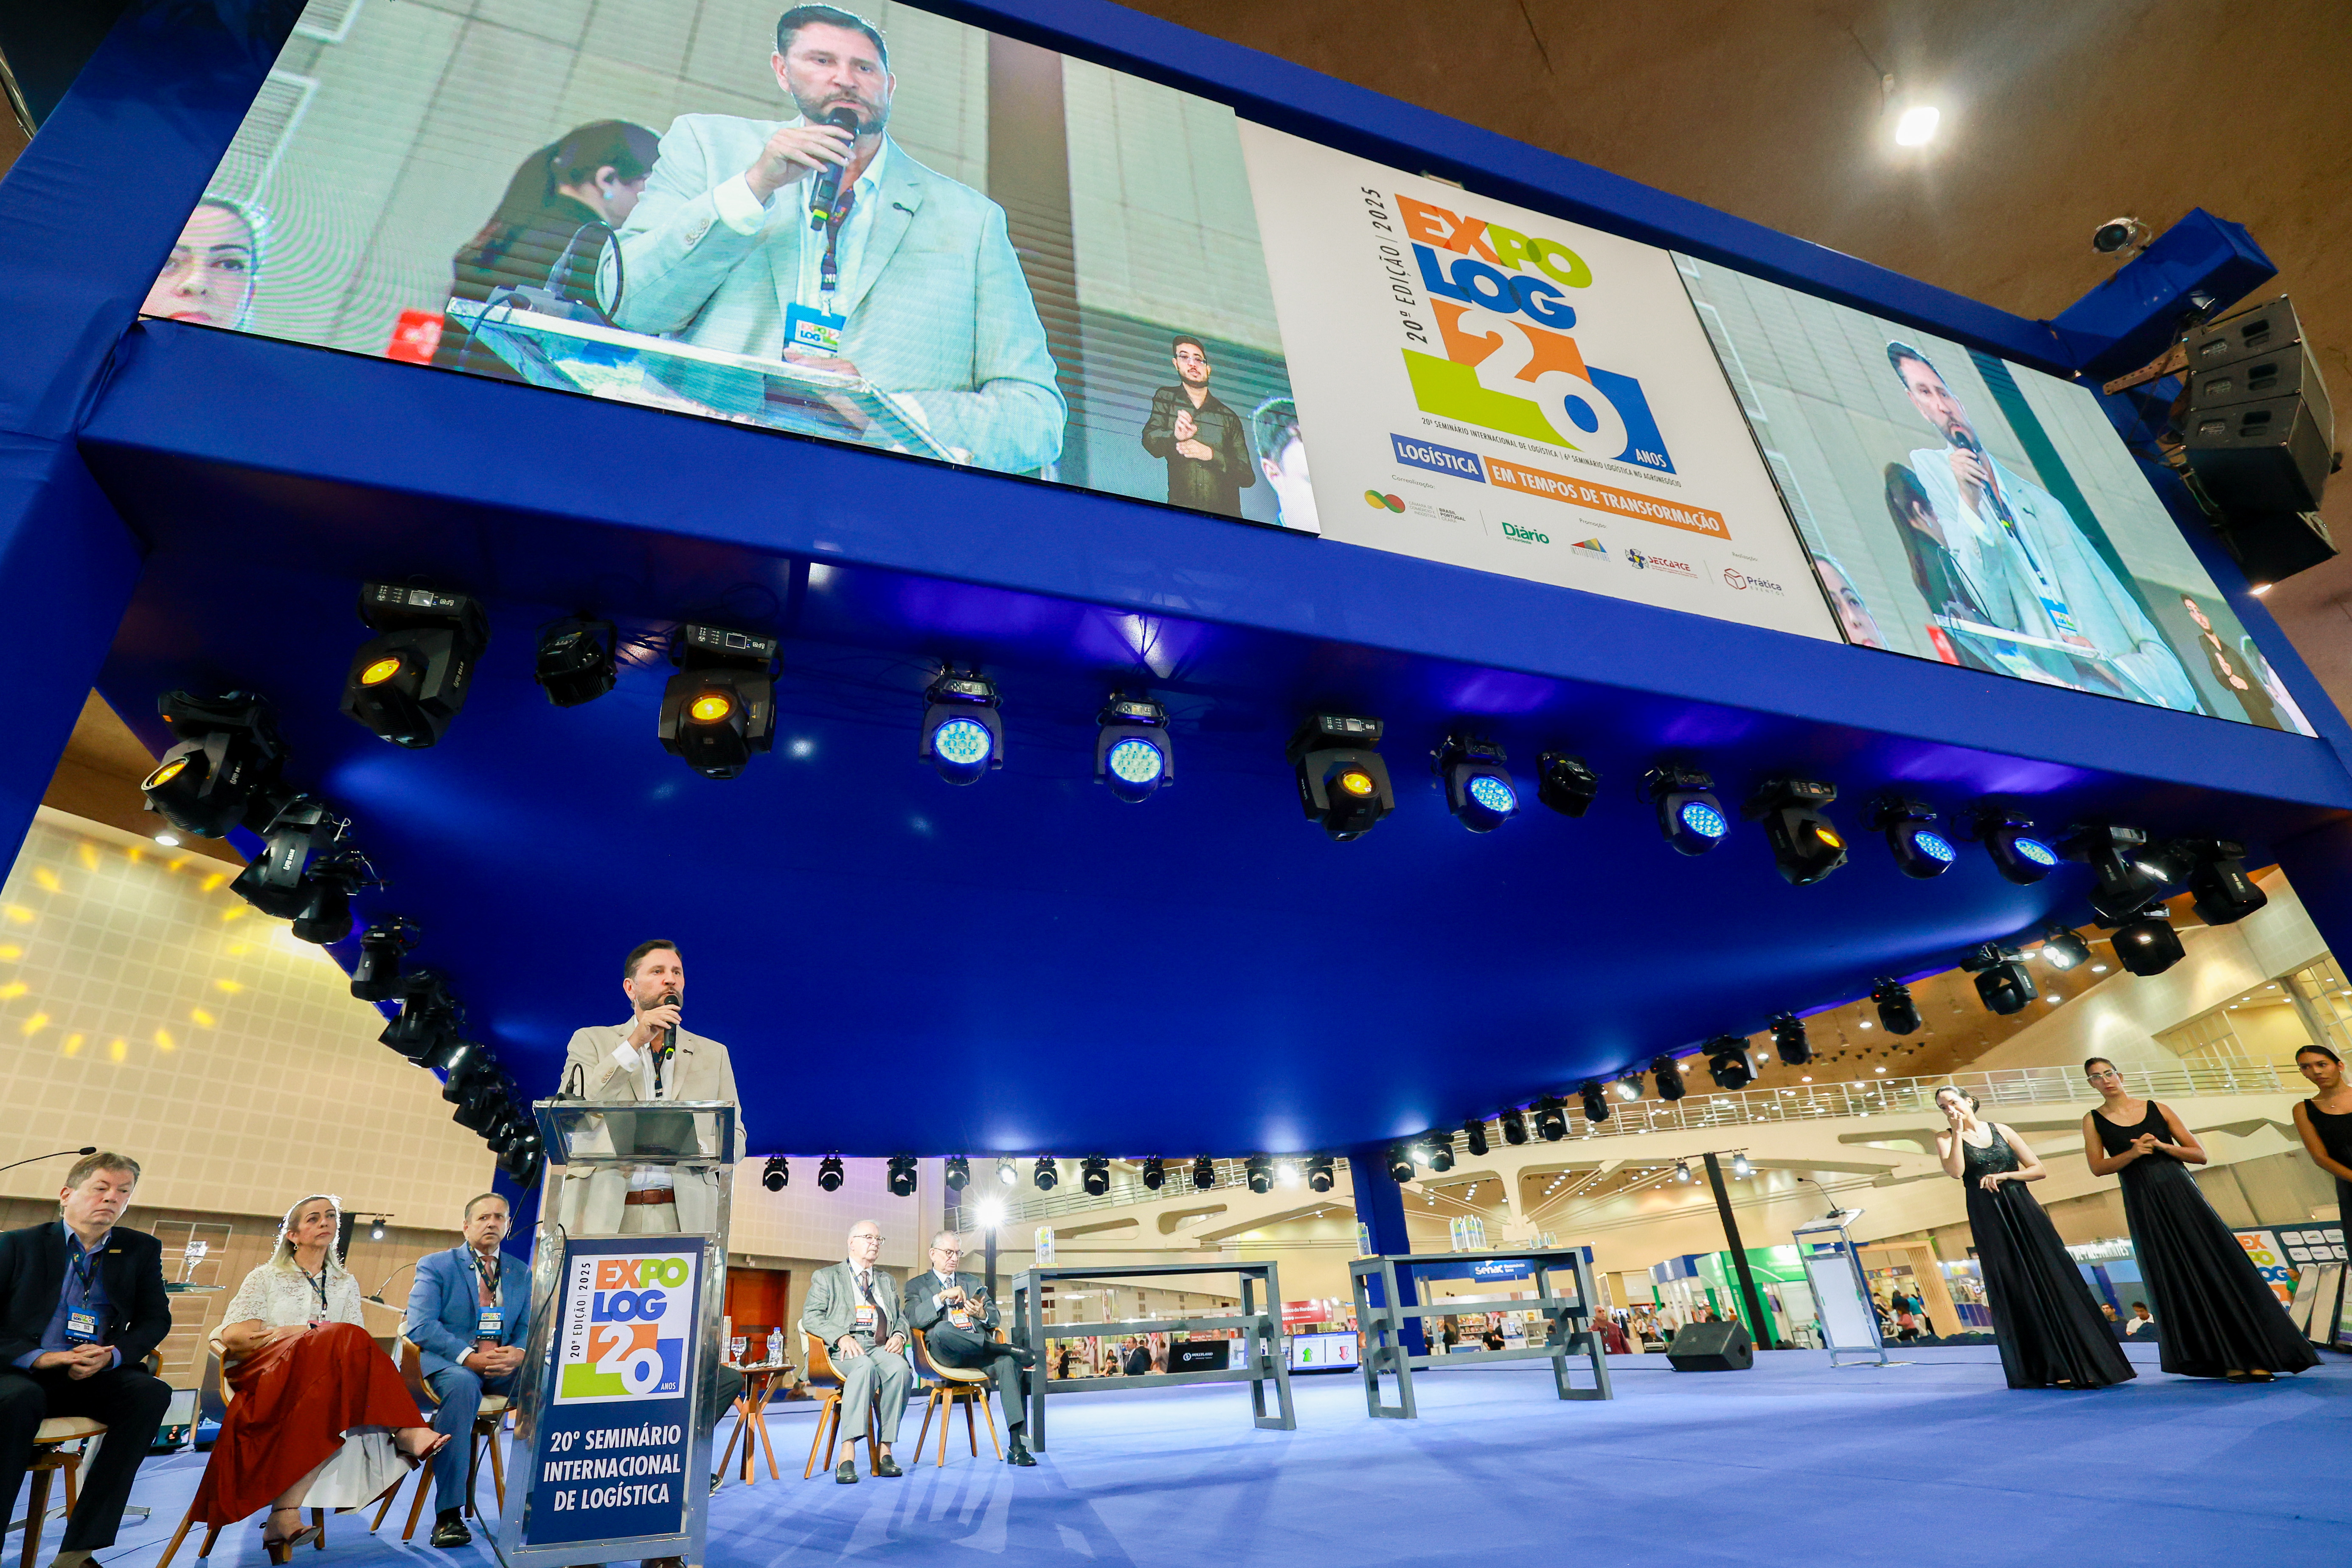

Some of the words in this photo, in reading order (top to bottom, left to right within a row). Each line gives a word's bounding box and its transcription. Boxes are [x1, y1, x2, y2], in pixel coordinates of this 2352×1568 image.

[1361, 186, 1392, 233] 2025
[1394, 193, 1592, 288] EXPO
[1379, 245, 1416, 306] EDIÇÃO
[1411, 242, 1576, 329] LOG
[801, 330, 821, 341] LOG
[1399, 310, 1427, 344] 20ª
[1458, 308, 1628, 460] 20
[1397, 441, 1479, 475] LOGÍSTICA
[1434, 421, 1469, 435] SEMINÁRIO
[1470, 430, 1517, 447] INTERNACIONAL
[1528, 444, 1558, 458] LOGÍSTICA
[1571, 456, 1603, 468] SEMINÁRIO
[1604, 463, 1633, 476] LOGÍSTICA
[1644, 473, 1681, 487] AGRONEGÓCIO
[1635, 448, 1667, 468] ANOS
[1492, 465, 1517, 484] EM
[1517, 471, 1578, 498] TEMPOS
[1579, 486, 1600, 504] DE
[1600, 491, 1720, 531] TRANSFORMAÇÃO
[1440, 512, 1466, 521] PORTUGAL
[1501, 522, 1549, 544] Diário
[1648, 556, 1691, 571] SETCARCE
[1747, 576, 1782, 590] Prática
[287, 849, 295, 860] BEAM
[2236, 1234, 2268, 1250] EX
[579, 1262, 591, 1290] 2025
[595, 1257, 689, 1290] EXPO
[573, 1301, 586, 1336] EDIÇÃO
[591, 1290, 667, 1322] LOG
[570, 1340, 580, 1358] 20ª
[596, 1324, 663, 1394] 20
[661, 1382, 676, 1391] ANOS
[549, 1430, 581, 1453] 20º
[585, 1422, 681, 1450] SEMINÁRIO
[543, 1453, 681, 1482] INTERNACIONAL
[554, 1489, 575, 1512] DE
[581, 1482, 669, 1509] LOGÍSTICA
